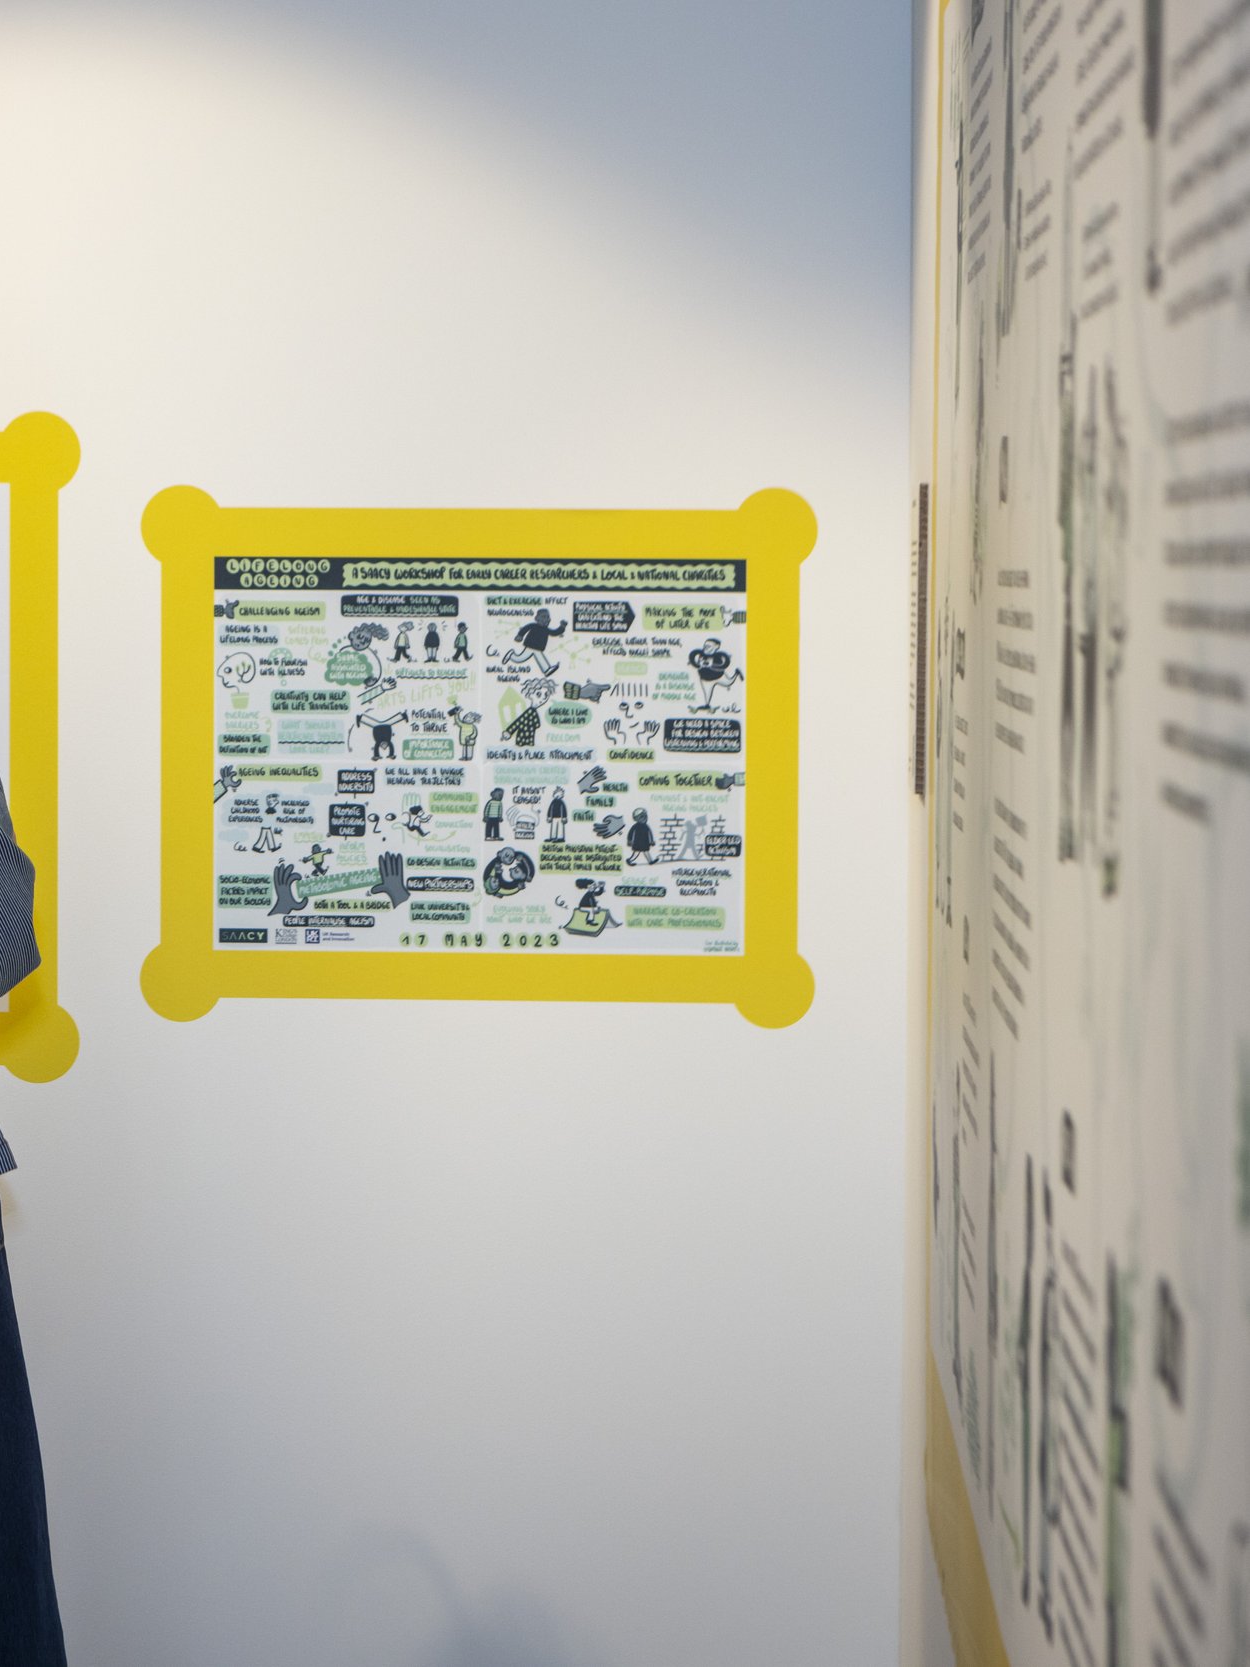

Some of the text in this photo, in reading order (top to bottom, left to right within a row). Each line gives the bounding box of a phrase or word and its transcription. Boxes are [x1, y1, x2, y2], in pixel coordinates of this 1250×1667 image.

[394, 566, 446, 580] WORKSHOP
[494, 568, 527, 580] CAREER
[530, 567, 590, 580] RESEARCHERS
[221, 931, 264, 940] SAACY
